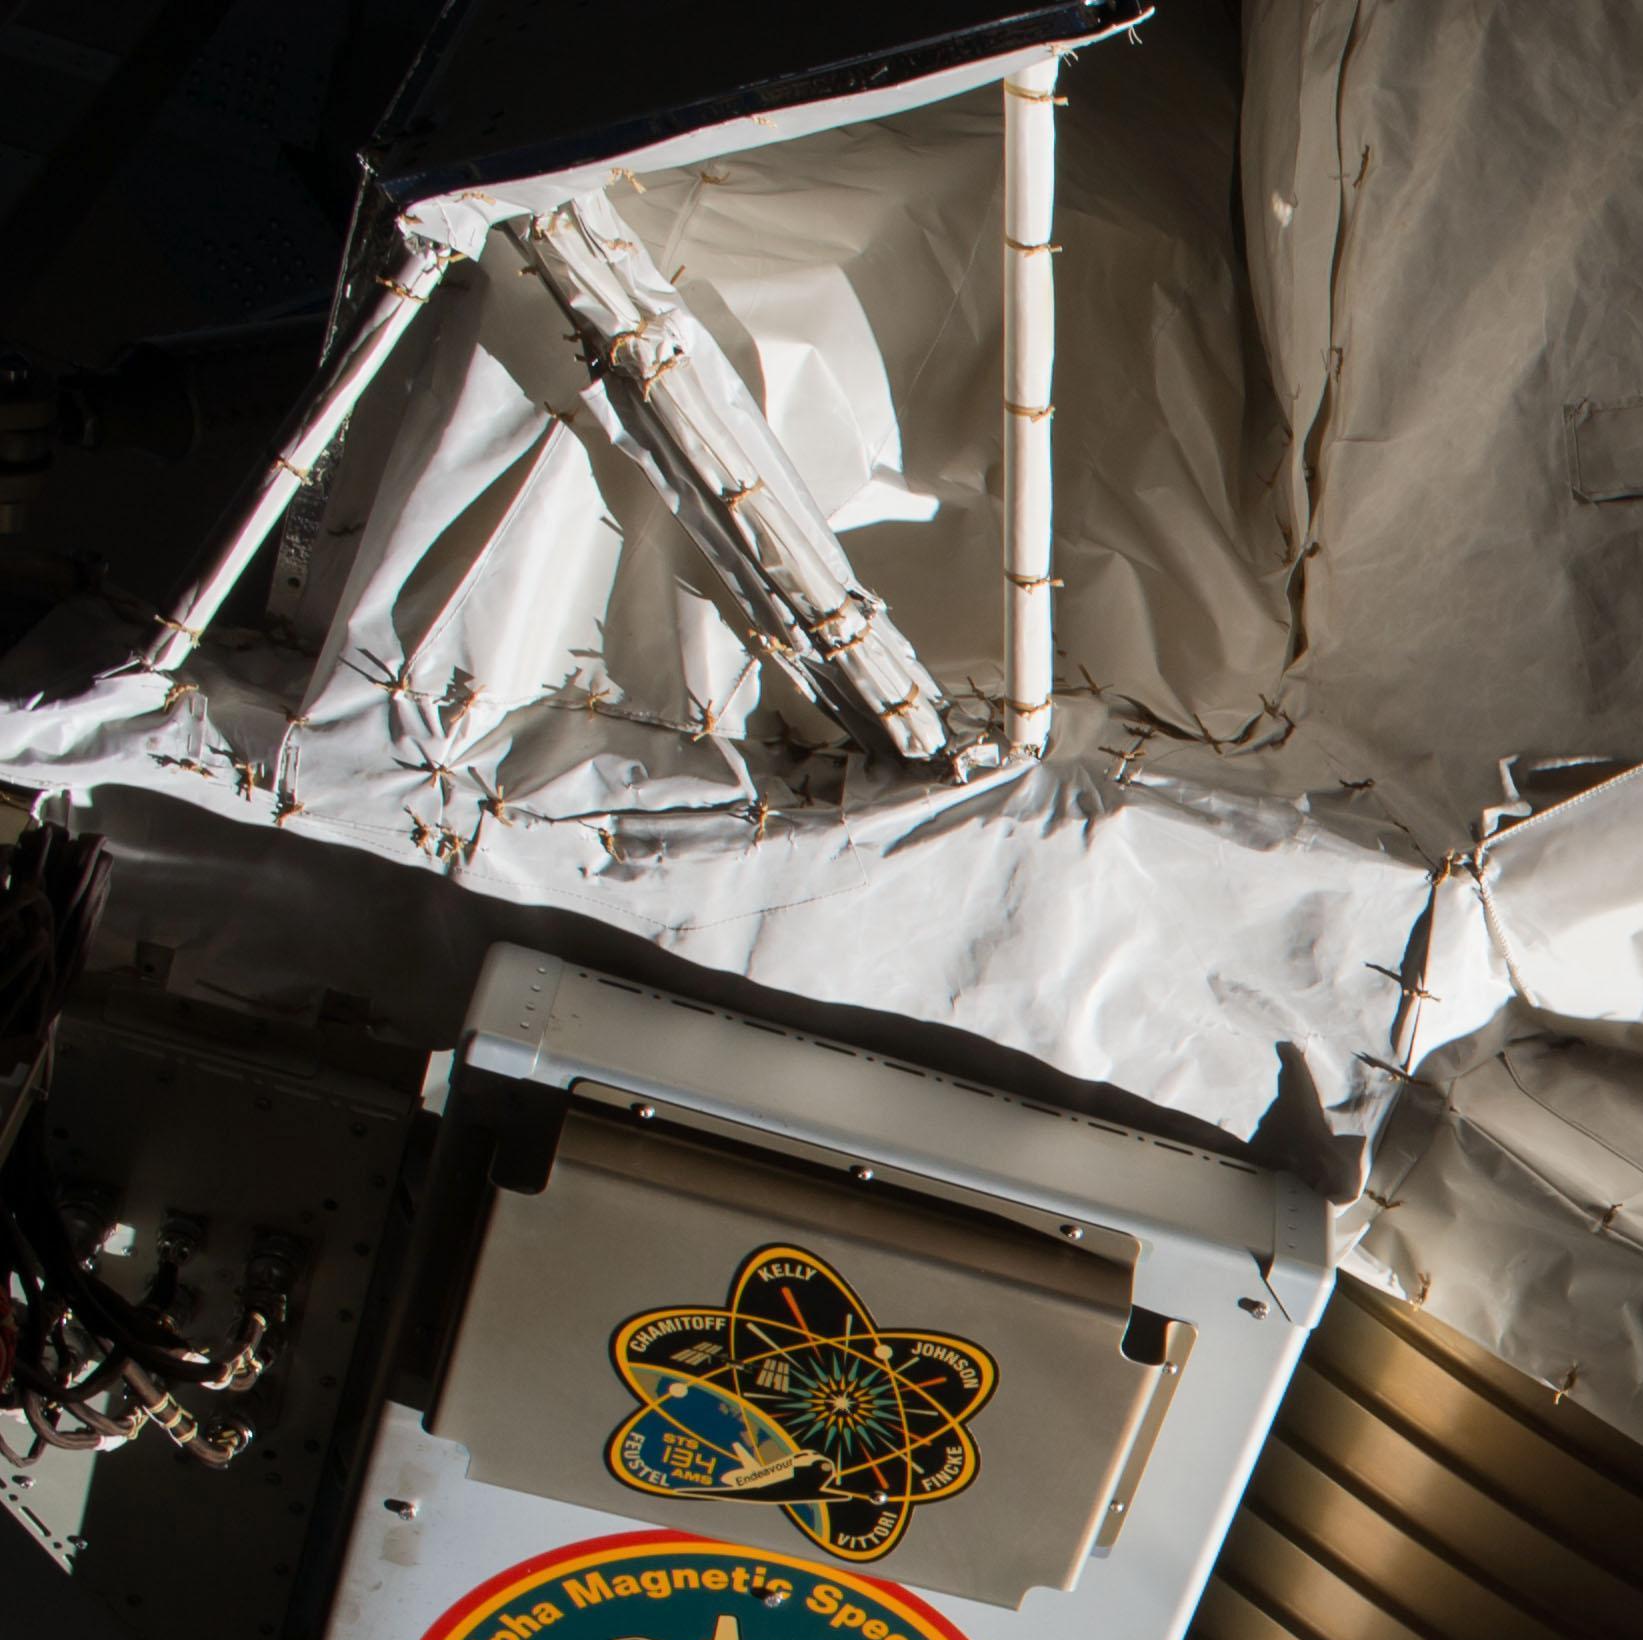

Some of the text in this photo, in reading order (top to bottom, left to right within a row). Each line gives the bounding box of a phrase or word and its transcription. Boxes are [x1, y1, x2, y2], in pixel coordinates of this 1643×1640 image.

[757, 1262, 819, 1284] KELLY
[629, 1315, 728, 1354] CHAMITOFF
[910, 1341, 981, 1390] JOHNSON
[623, 1431, 670, 1488] FEUSTEL
[661, 1432, 700, 1450] STS
[661, 1445, 718, 1475] 134
[670, 1467, 714, 1486] AMS
[735, 1458, 794, 1488] Endeavour
[921, 1444, 963, 1492] FINCKE
[836, 1510, 898, 1550] VITTORI
[561, 1564, 794, 1611] Magnetic
